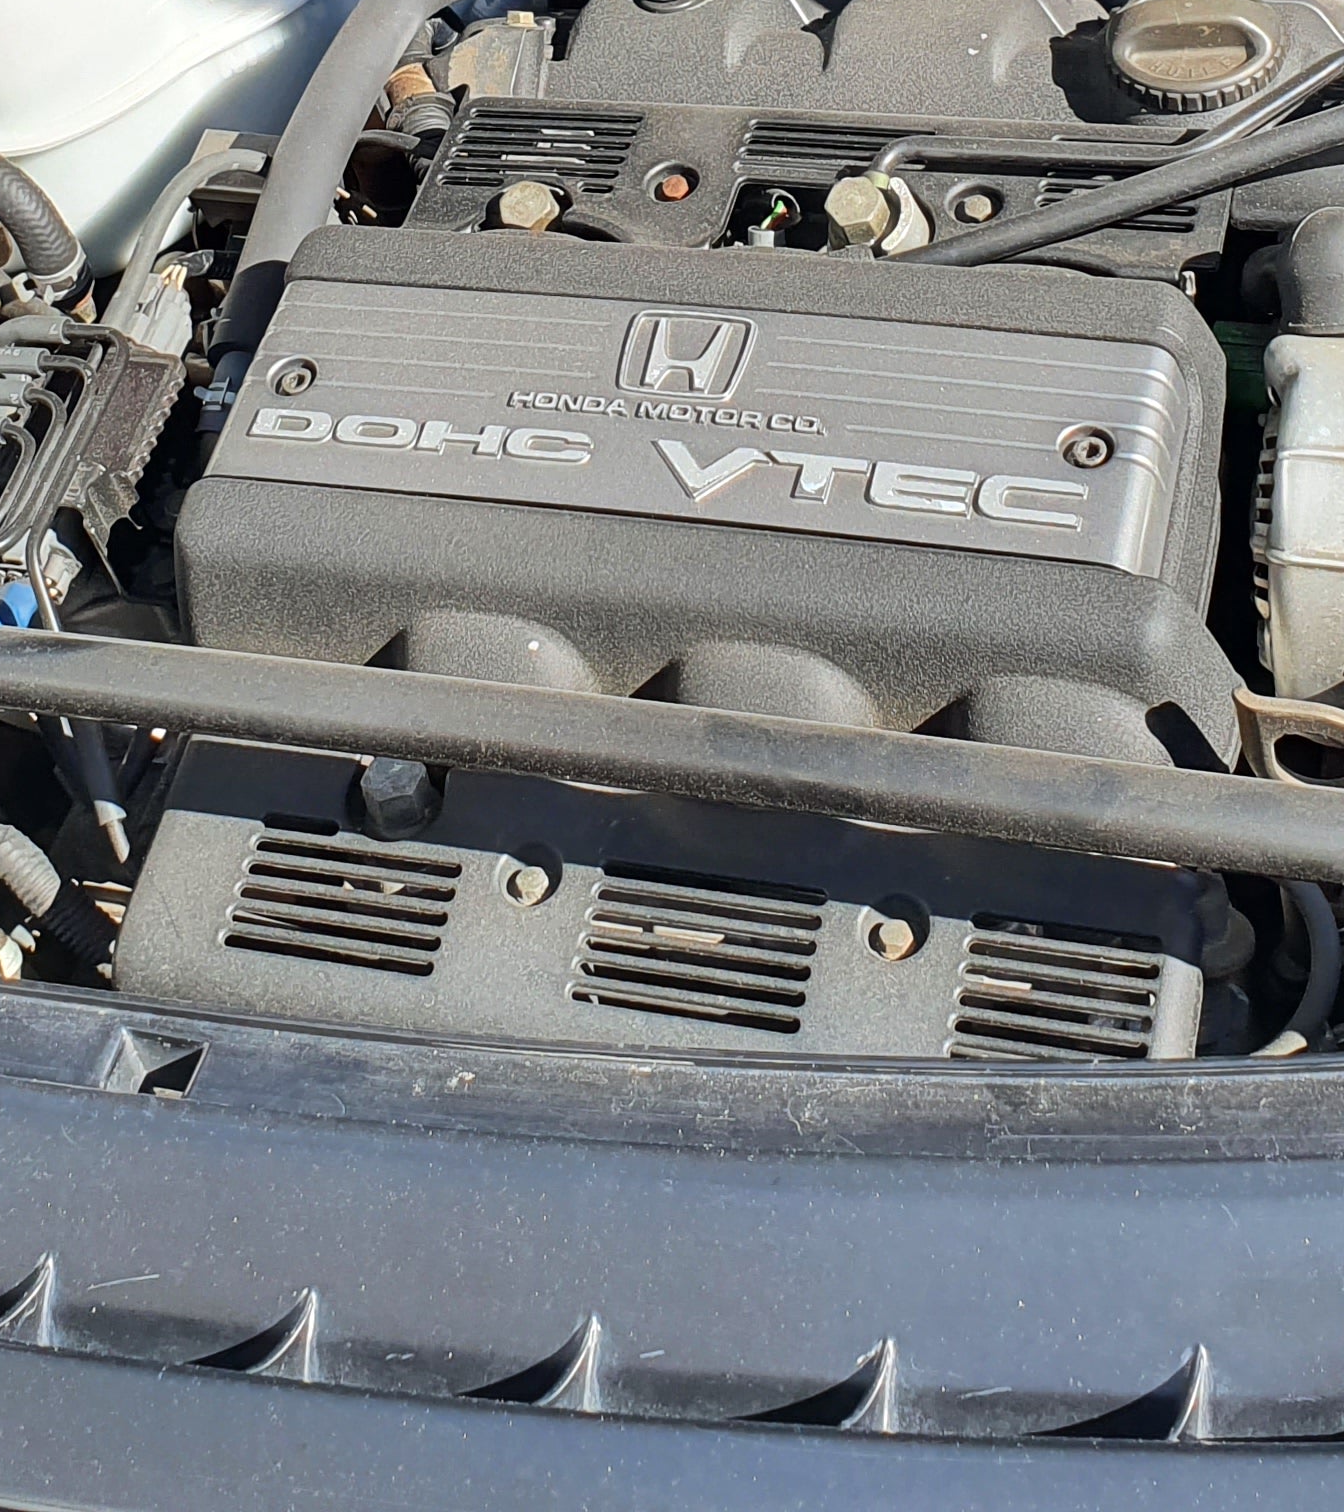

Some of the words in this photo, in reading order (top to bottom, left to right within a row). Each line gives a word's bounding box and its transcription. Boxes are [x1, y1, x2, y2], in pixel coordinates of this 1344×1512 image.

[247, 407, 595, 465] DOHC
[506, 390, 628, 418] HONDA
[634, 400, 763, 430] MOTOR
[766, 412, 827, 435] CO.
[651, 438, 1089, 532] VTEC
